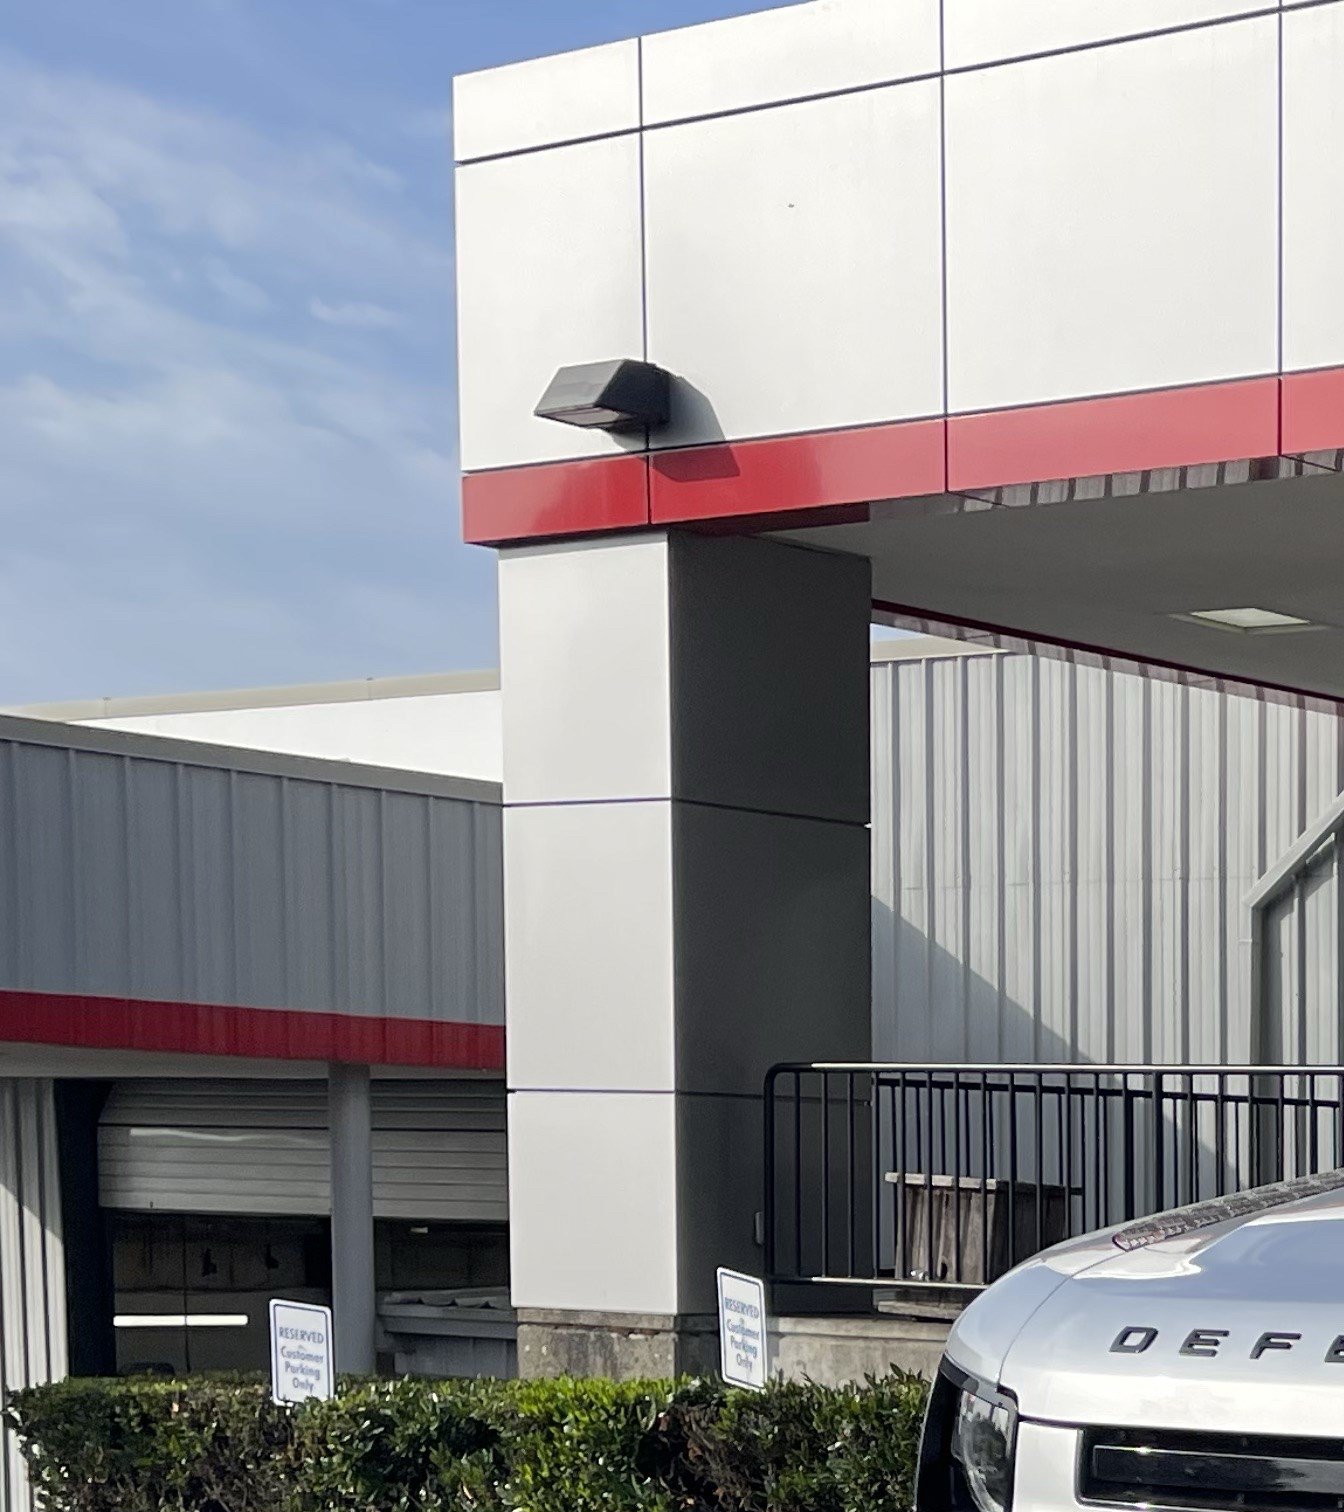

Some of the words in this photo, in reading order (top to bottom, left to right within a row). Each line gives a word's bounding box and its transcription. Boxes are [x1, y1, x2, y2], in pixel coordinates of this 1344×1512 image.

[725, 1297, 760, 1319] RESERVED
[279, 1326, 324, 1344] RESERVED
[726, 1319, 760, 1340] Customer
[280, 1345, 324, 1363] Customer
[730, 1335, 758, 1359] Parking
[285, 1361, 321, 1381] Parking
[736, 1353, 753, 1373] Only
[292, 1377, 315, 1393] Only
